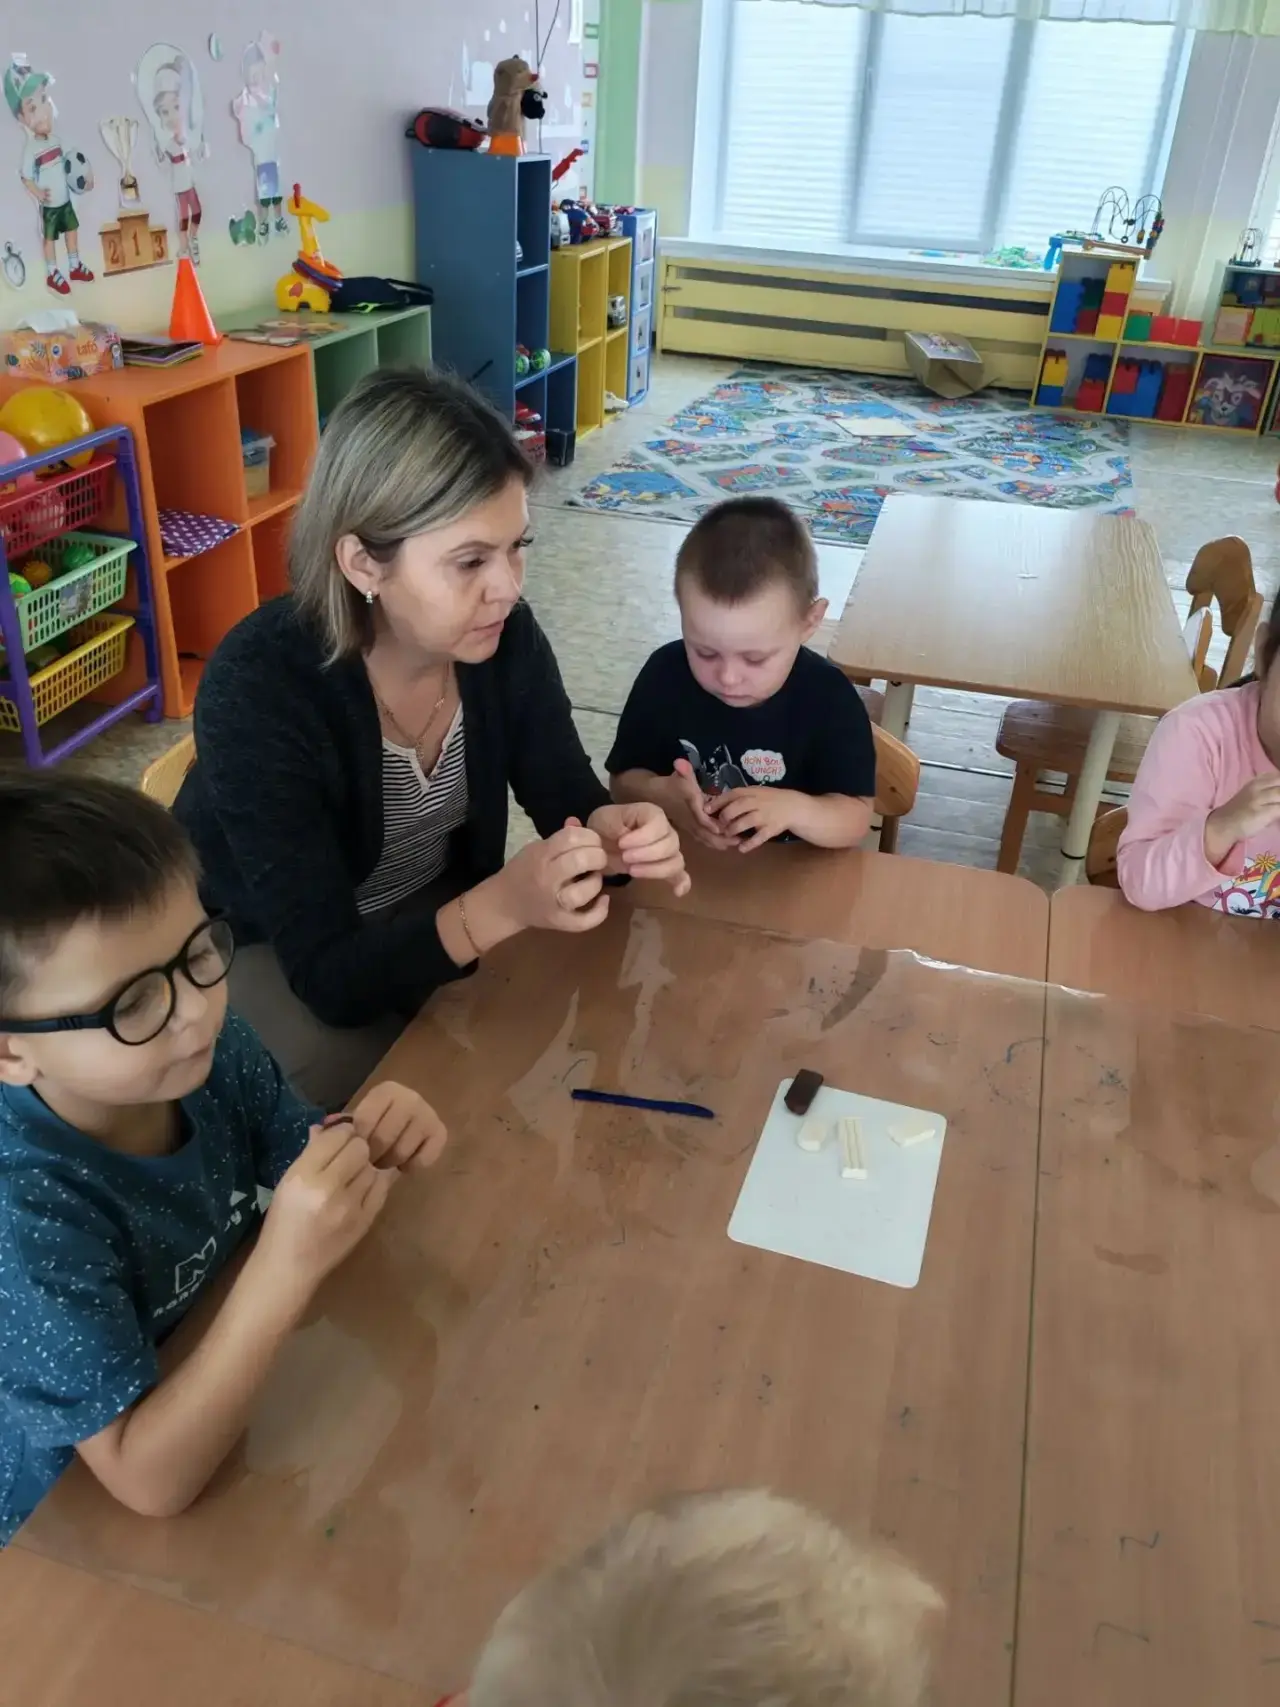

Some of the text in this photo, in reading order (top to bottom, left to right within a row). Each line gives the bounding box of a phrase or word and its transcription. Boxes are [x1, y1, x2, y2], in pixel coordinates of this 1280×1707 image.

[108, 229, 165, 265] 2 1 3
